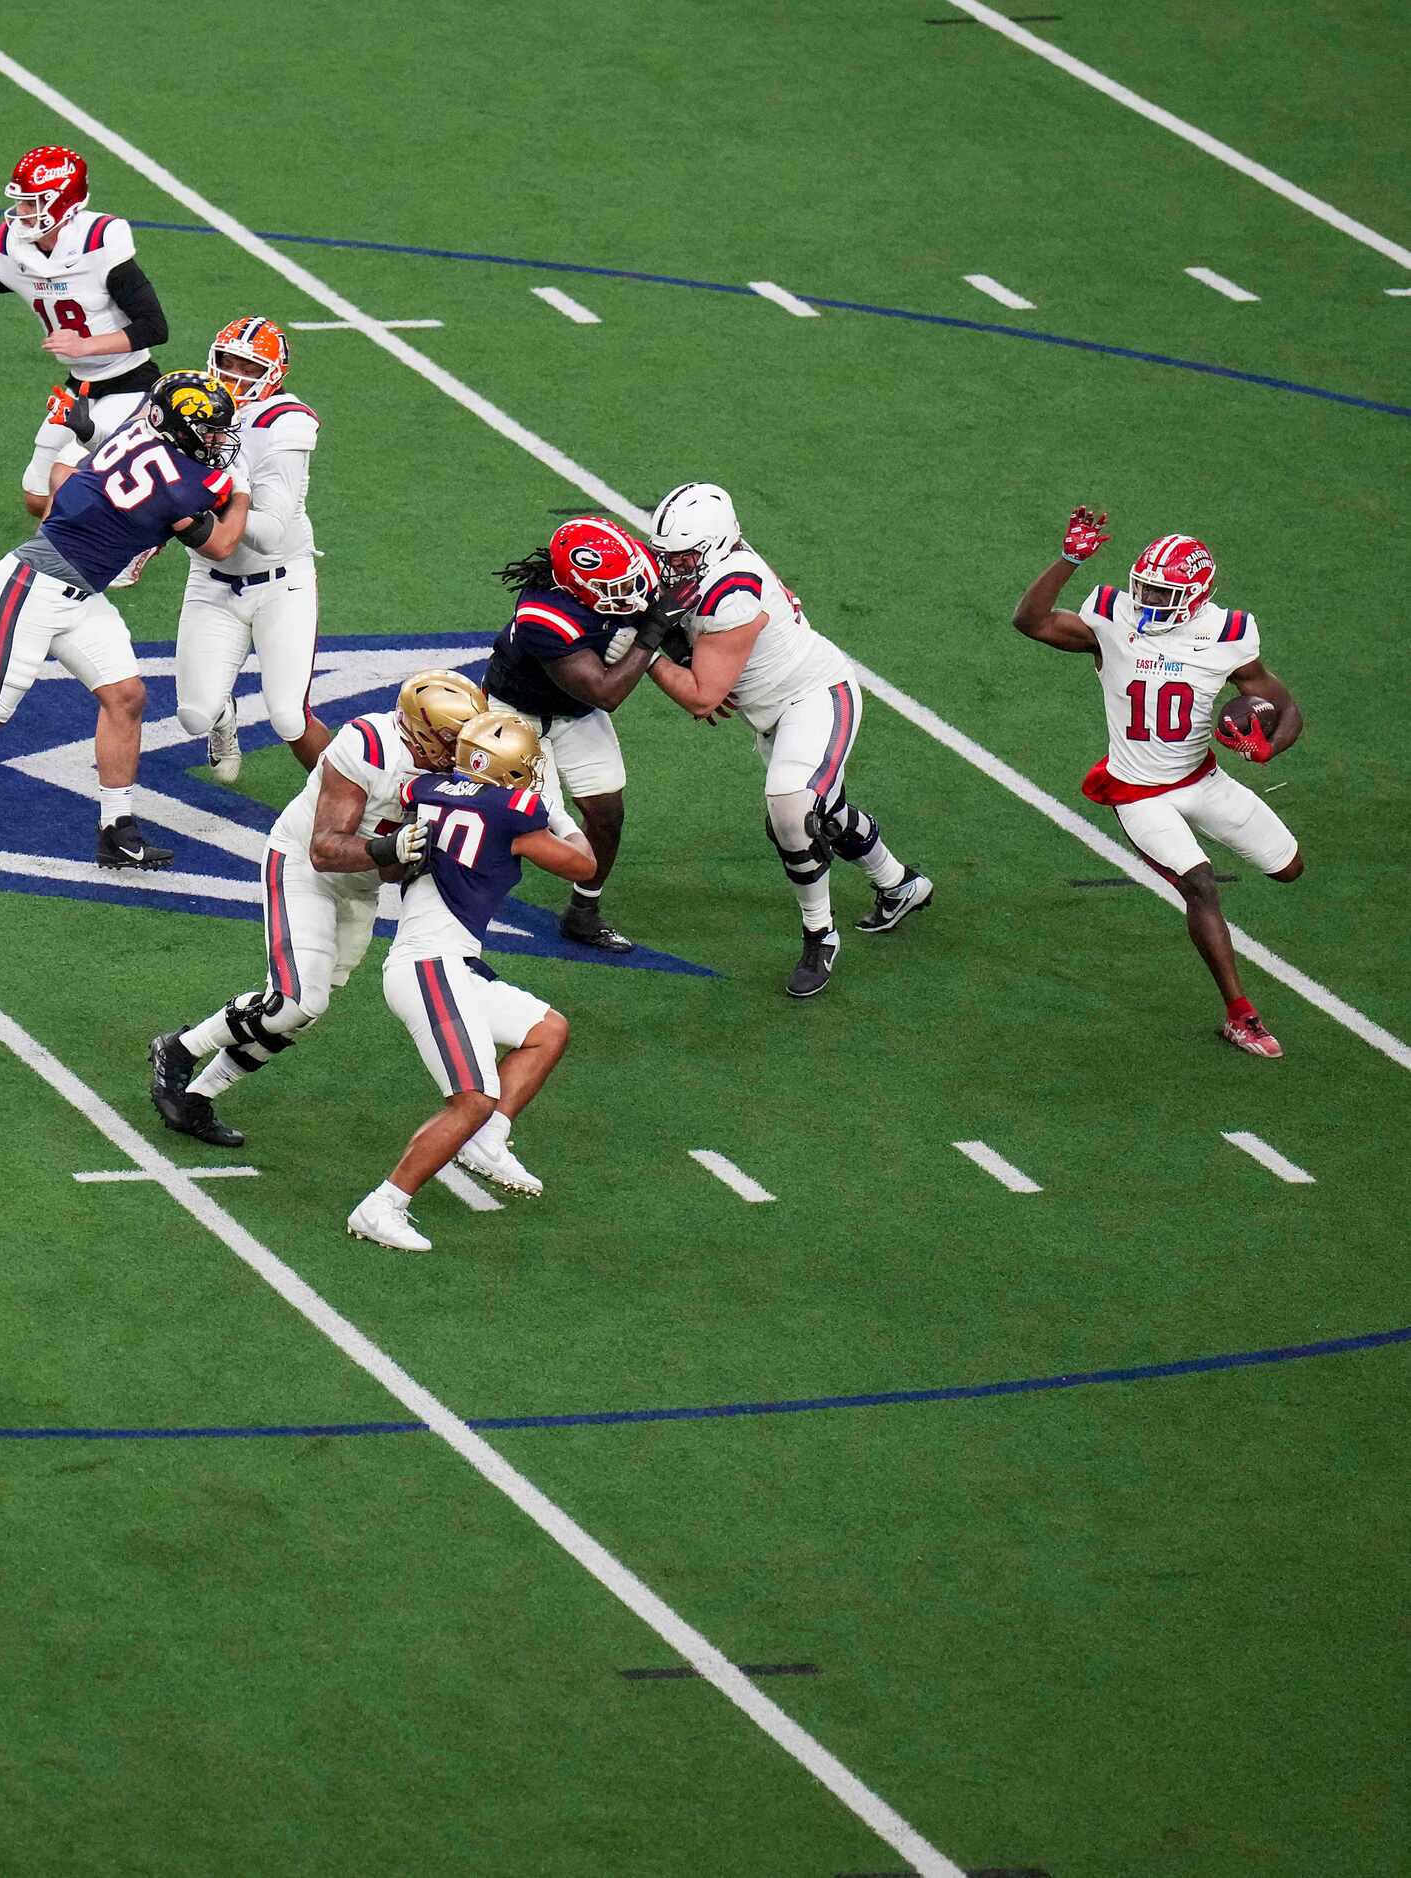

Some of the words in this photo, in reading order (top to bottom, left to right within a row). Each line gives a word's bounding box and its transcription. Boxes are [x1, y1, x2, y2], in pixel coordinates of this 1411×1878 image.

[32, 157, 76, 185] Cards
[33, 299, 92, 338] 18
[92, 418, 182, 510] 85
[572, 547, 602, 569] G
[1136, 659, 1154, 669] EAST
[1164, 662, 1183, 672] WEST
[1126, 680, 1195, 743] 10
